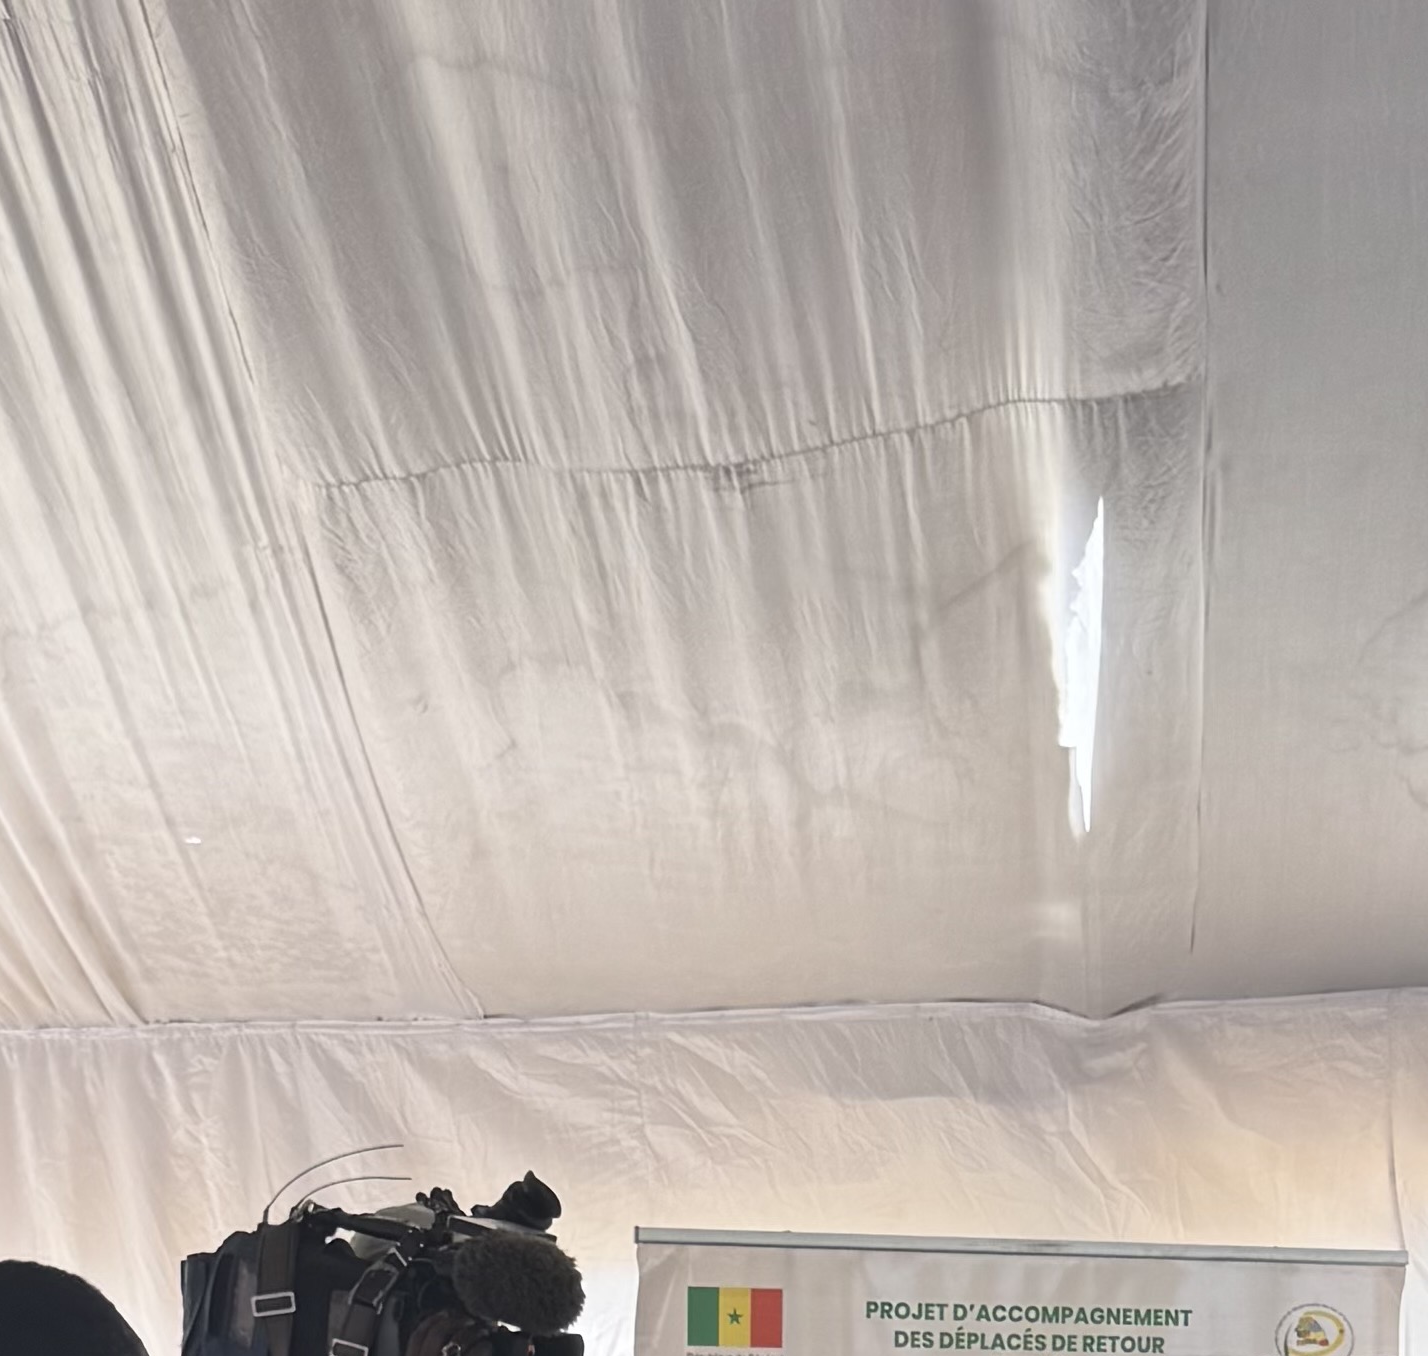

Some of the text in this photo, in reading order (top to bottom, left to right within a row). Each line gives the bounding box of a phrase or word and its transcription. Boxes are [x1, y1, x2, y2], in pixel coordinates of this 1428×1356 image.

[865, 1301, 1193, 1327] PROJET D'ACCOMPAGNEMENT
[894, 1326, 1165, 1354] DES DÉPLACÉS DE RETOUR
